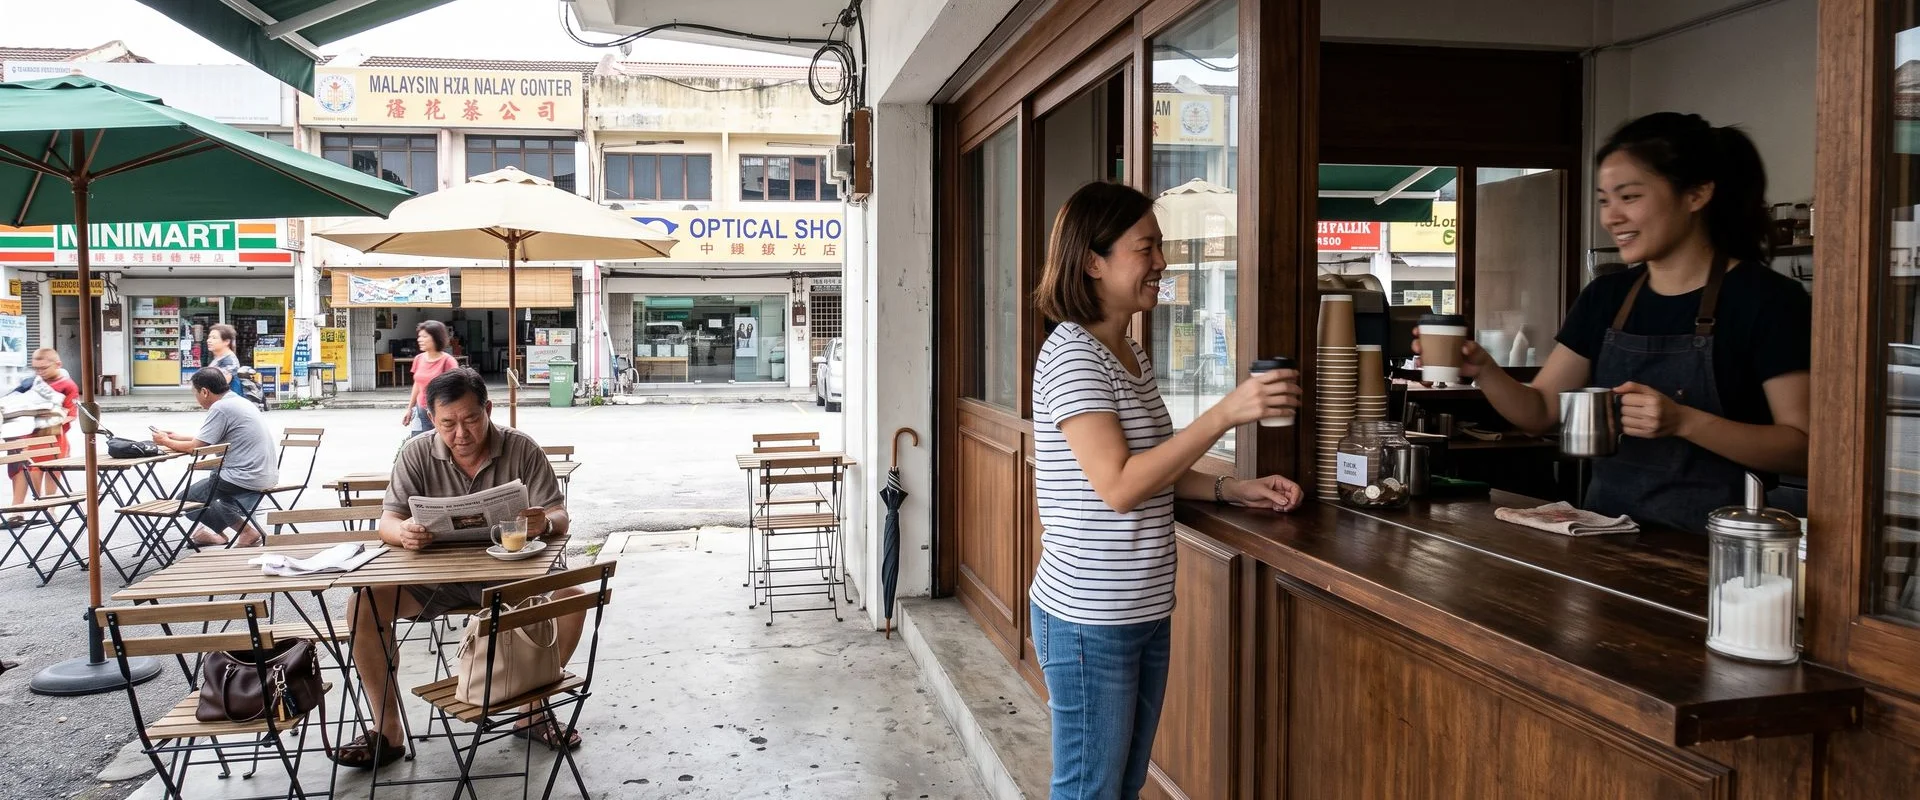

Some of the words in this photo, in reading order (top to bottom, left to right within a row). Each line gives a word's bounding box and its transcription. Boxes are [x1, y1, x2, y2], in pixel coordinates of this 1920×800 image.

[369, 75, 438, 94] MALAYSIN
[61, 222, 231, 248] MINIMART
[689, 218, 788, 239] OPTICAL
[794, 219, 842, 240] SHO
